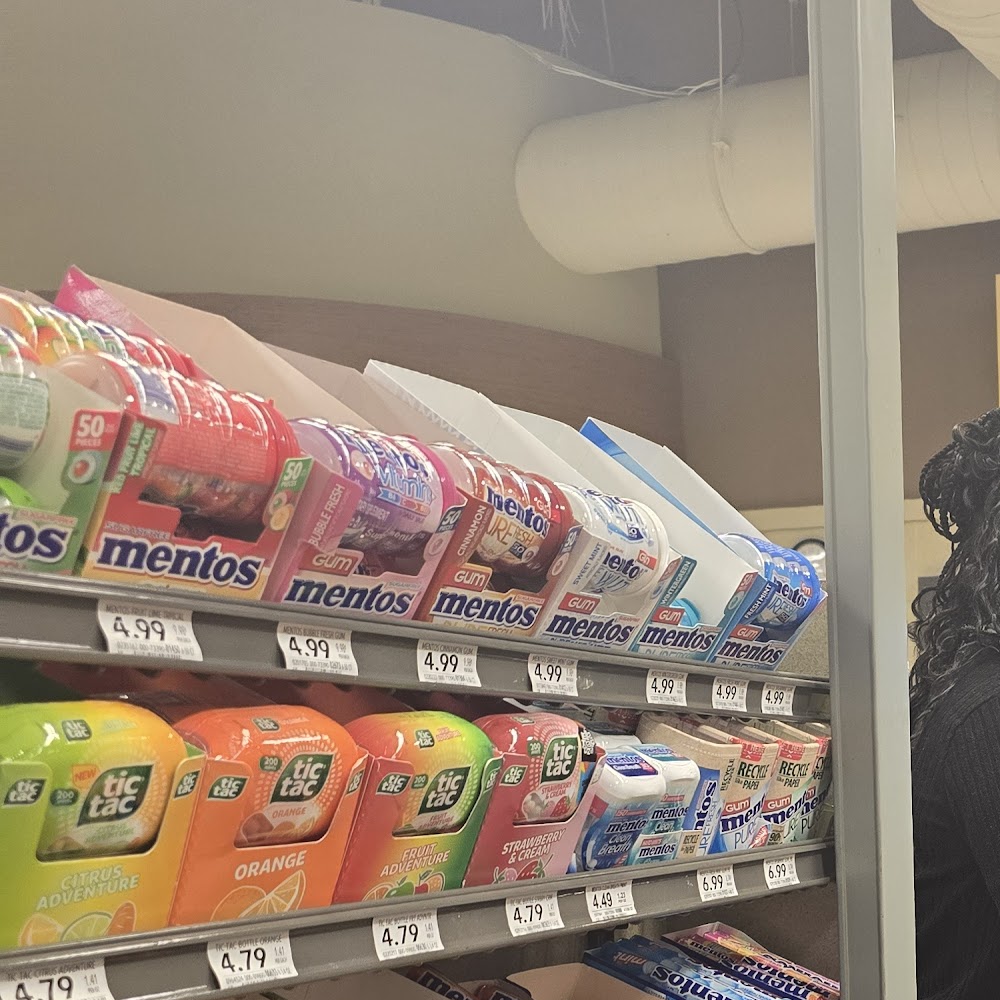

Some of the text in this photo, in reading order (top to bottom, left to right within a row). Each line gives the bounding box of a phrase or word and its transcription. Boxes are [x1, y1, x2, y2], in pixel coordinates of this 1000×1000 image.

[77, 414, 105, 438] 50
[309, 485, 344, 546] BUBBLE FRESH
[458, 505, 487, 556] CINNAMON
[98, 536, 262, 586] mentos
[312, 554, 354, 572] GUM
[573, 544, 602, 585] SWEET MINT
[454, 570, 488, 586] GUM
[660, 561, 691, 604] WINTERGREEN
[283, 577, 414, 615] mentos
[568, 597, 596, 610] GUM
[744, 584, 772, 619] FRESH MINT
[432, 591, 539, 627] mentos
[659, 610, 682, 622] GUM
[113, 616, 166, 641] 4.99
[546, 614, 634, 643] mentos
[641, 625, 714, 651] mentos
[737, 628, 757, 640] GUM
[289, 637, 330, 659] 4.99
[718, 641, 782, 664] mentos
[424, 652, 459, 673] 4.99
[534, 663, 562, 682] 4.99
[651, 678, 674, 694] 4.99
[717, 685, 737, 700] 4.99
[766, 690, 785, 705] 4.99
[74, 768, 97, 782] NEW
[293, 756, 324, 779] tic
[104, 770, 143, 796] tic
[280, 775, 318, 797] tac
[56, 789, 76, 800] 200
[88, 791, 140, 818] tac
[767, 796, 792, 809] GUM
[272, 806, 308, 818] ORANGE
[651, 806, 690, 820] mentos
[725, 800, 750, 812] GUM
[402, 843, 437, 862] FRUIT
[501, 829, 566, 855] STRAWBERRY
[639, 843, 676, 857] mentos
[380, 850, 449, 877] ADVENTURE
[508, 845, 552, 863] & CREAM
[60, 864, 123, 889] CITRUS
[234, 850, 306, 881] ORANGE
[767, 861, 788, 879] 6.99
[36, 875, 140, 910] ADVENTURE
[702, 873, 724, 892] 6.99
[592, 888, 613, 908] 4.49
[513, 904, 543, 924] 4.79
[259, 935, 282, 945] ORANGE
[382, 924, 418, 946] 4.79
[221, 946, 285, 973] 4.79 1.41
